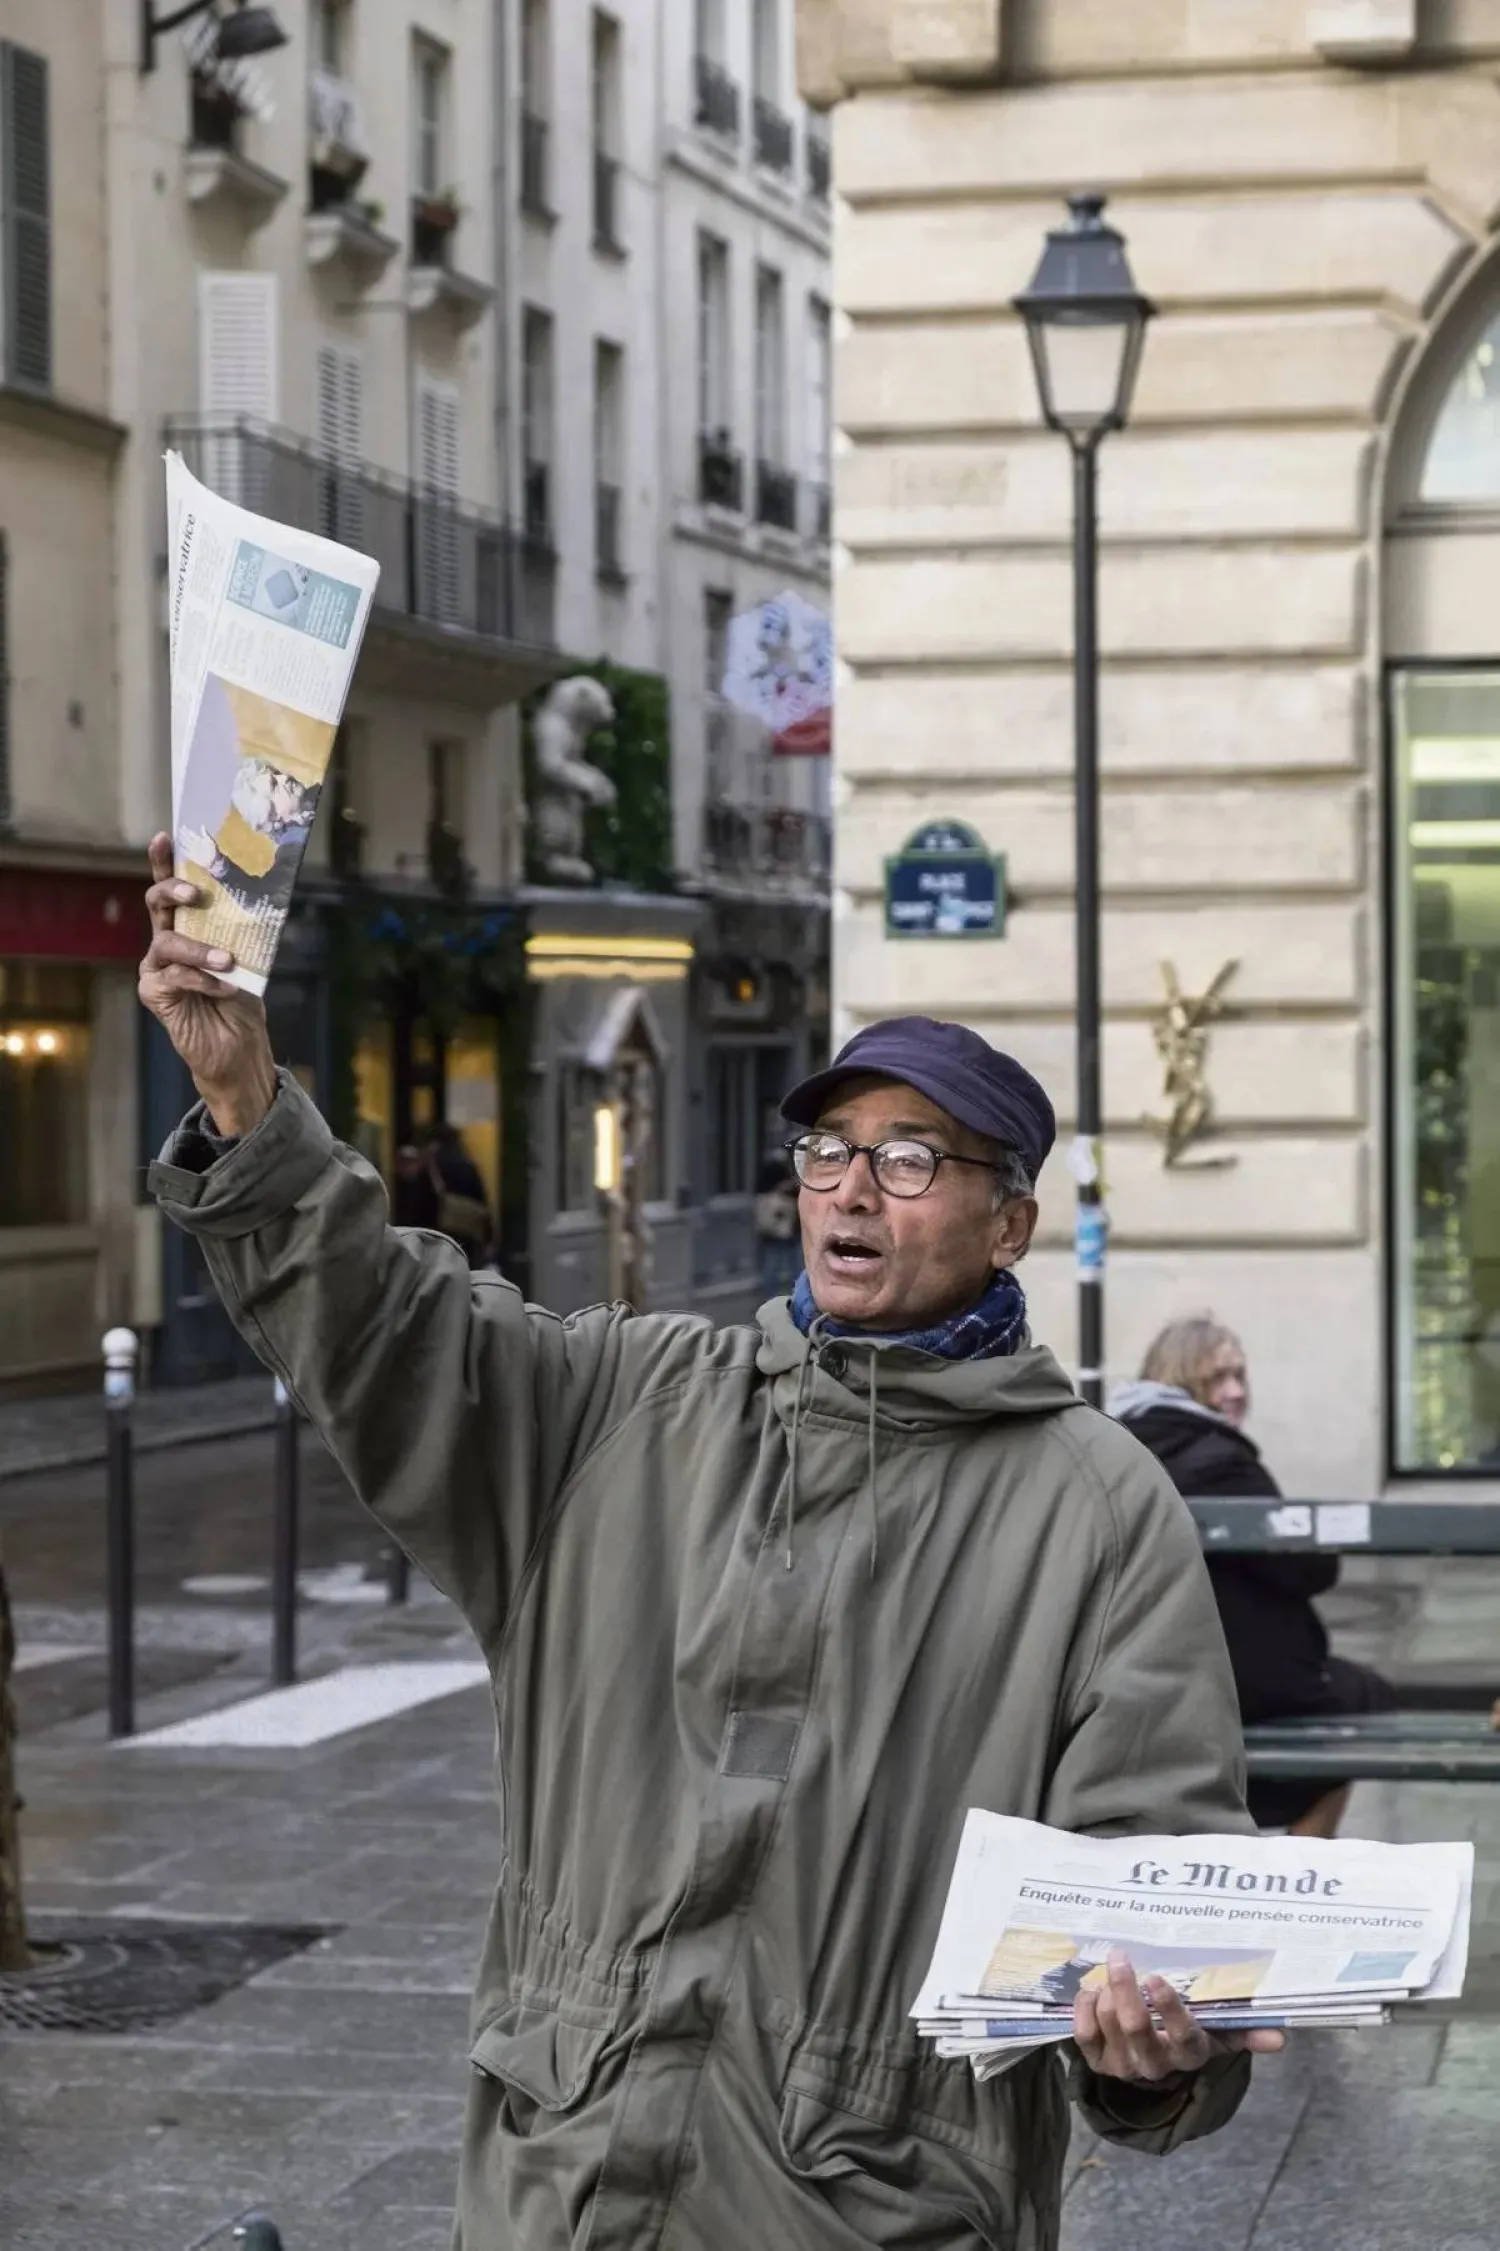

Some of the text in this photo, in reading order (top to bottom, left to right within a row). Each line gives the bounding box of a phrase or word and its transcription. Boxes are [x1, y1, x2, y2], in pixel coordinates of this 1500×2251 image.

[1120, 1860, 1344, 1897] Le Monde
[1018, 1885, 1424, 1929] Enquête sur la nouvelle pensée conservatrice
